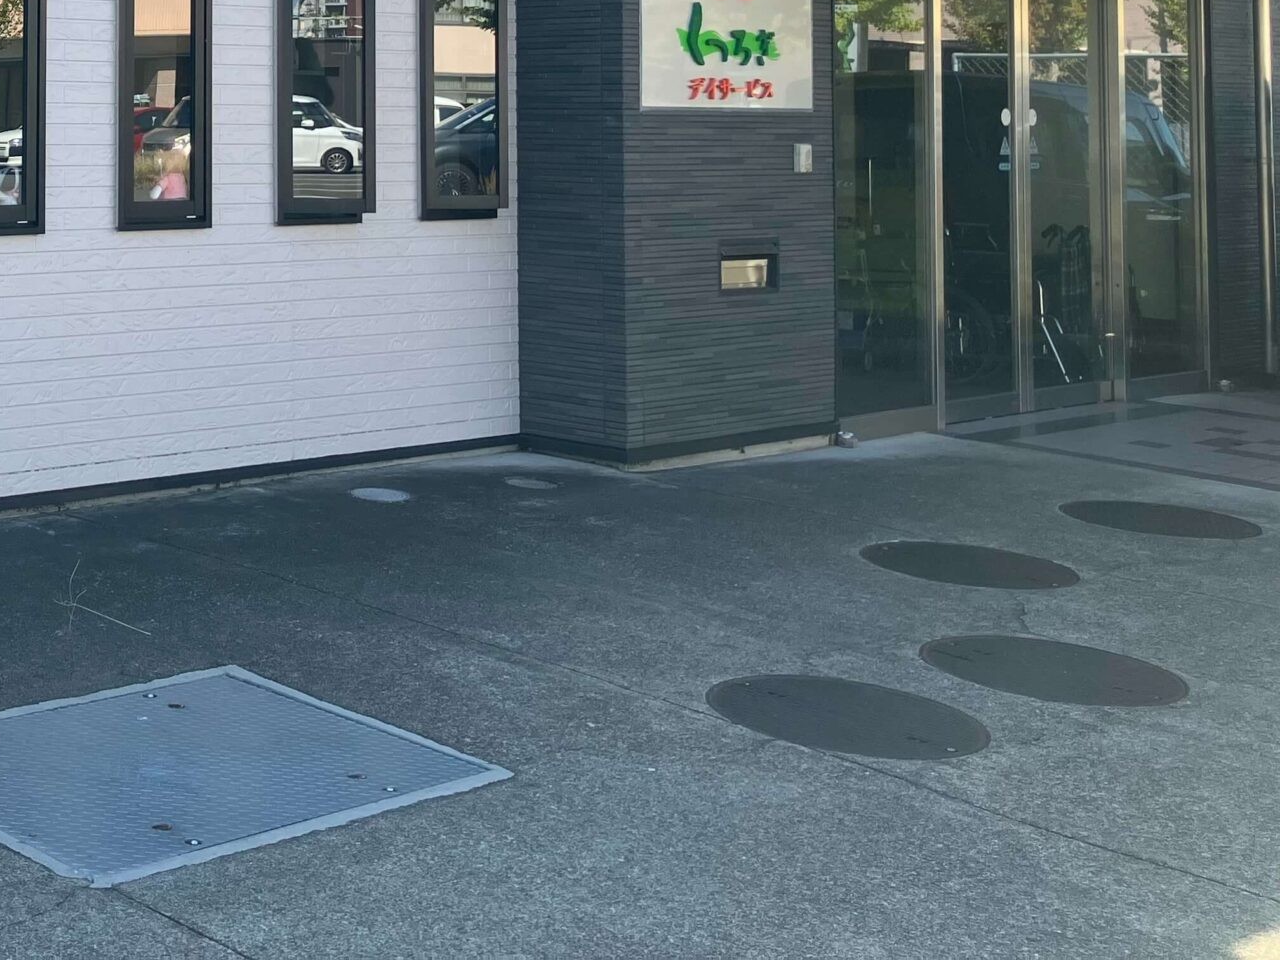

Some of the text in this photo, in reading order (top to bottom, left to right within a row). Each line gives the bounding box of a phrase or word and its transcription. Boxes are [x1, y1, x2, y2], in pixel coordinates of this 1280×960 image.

[688, 77, 773, 100] デイサービス
